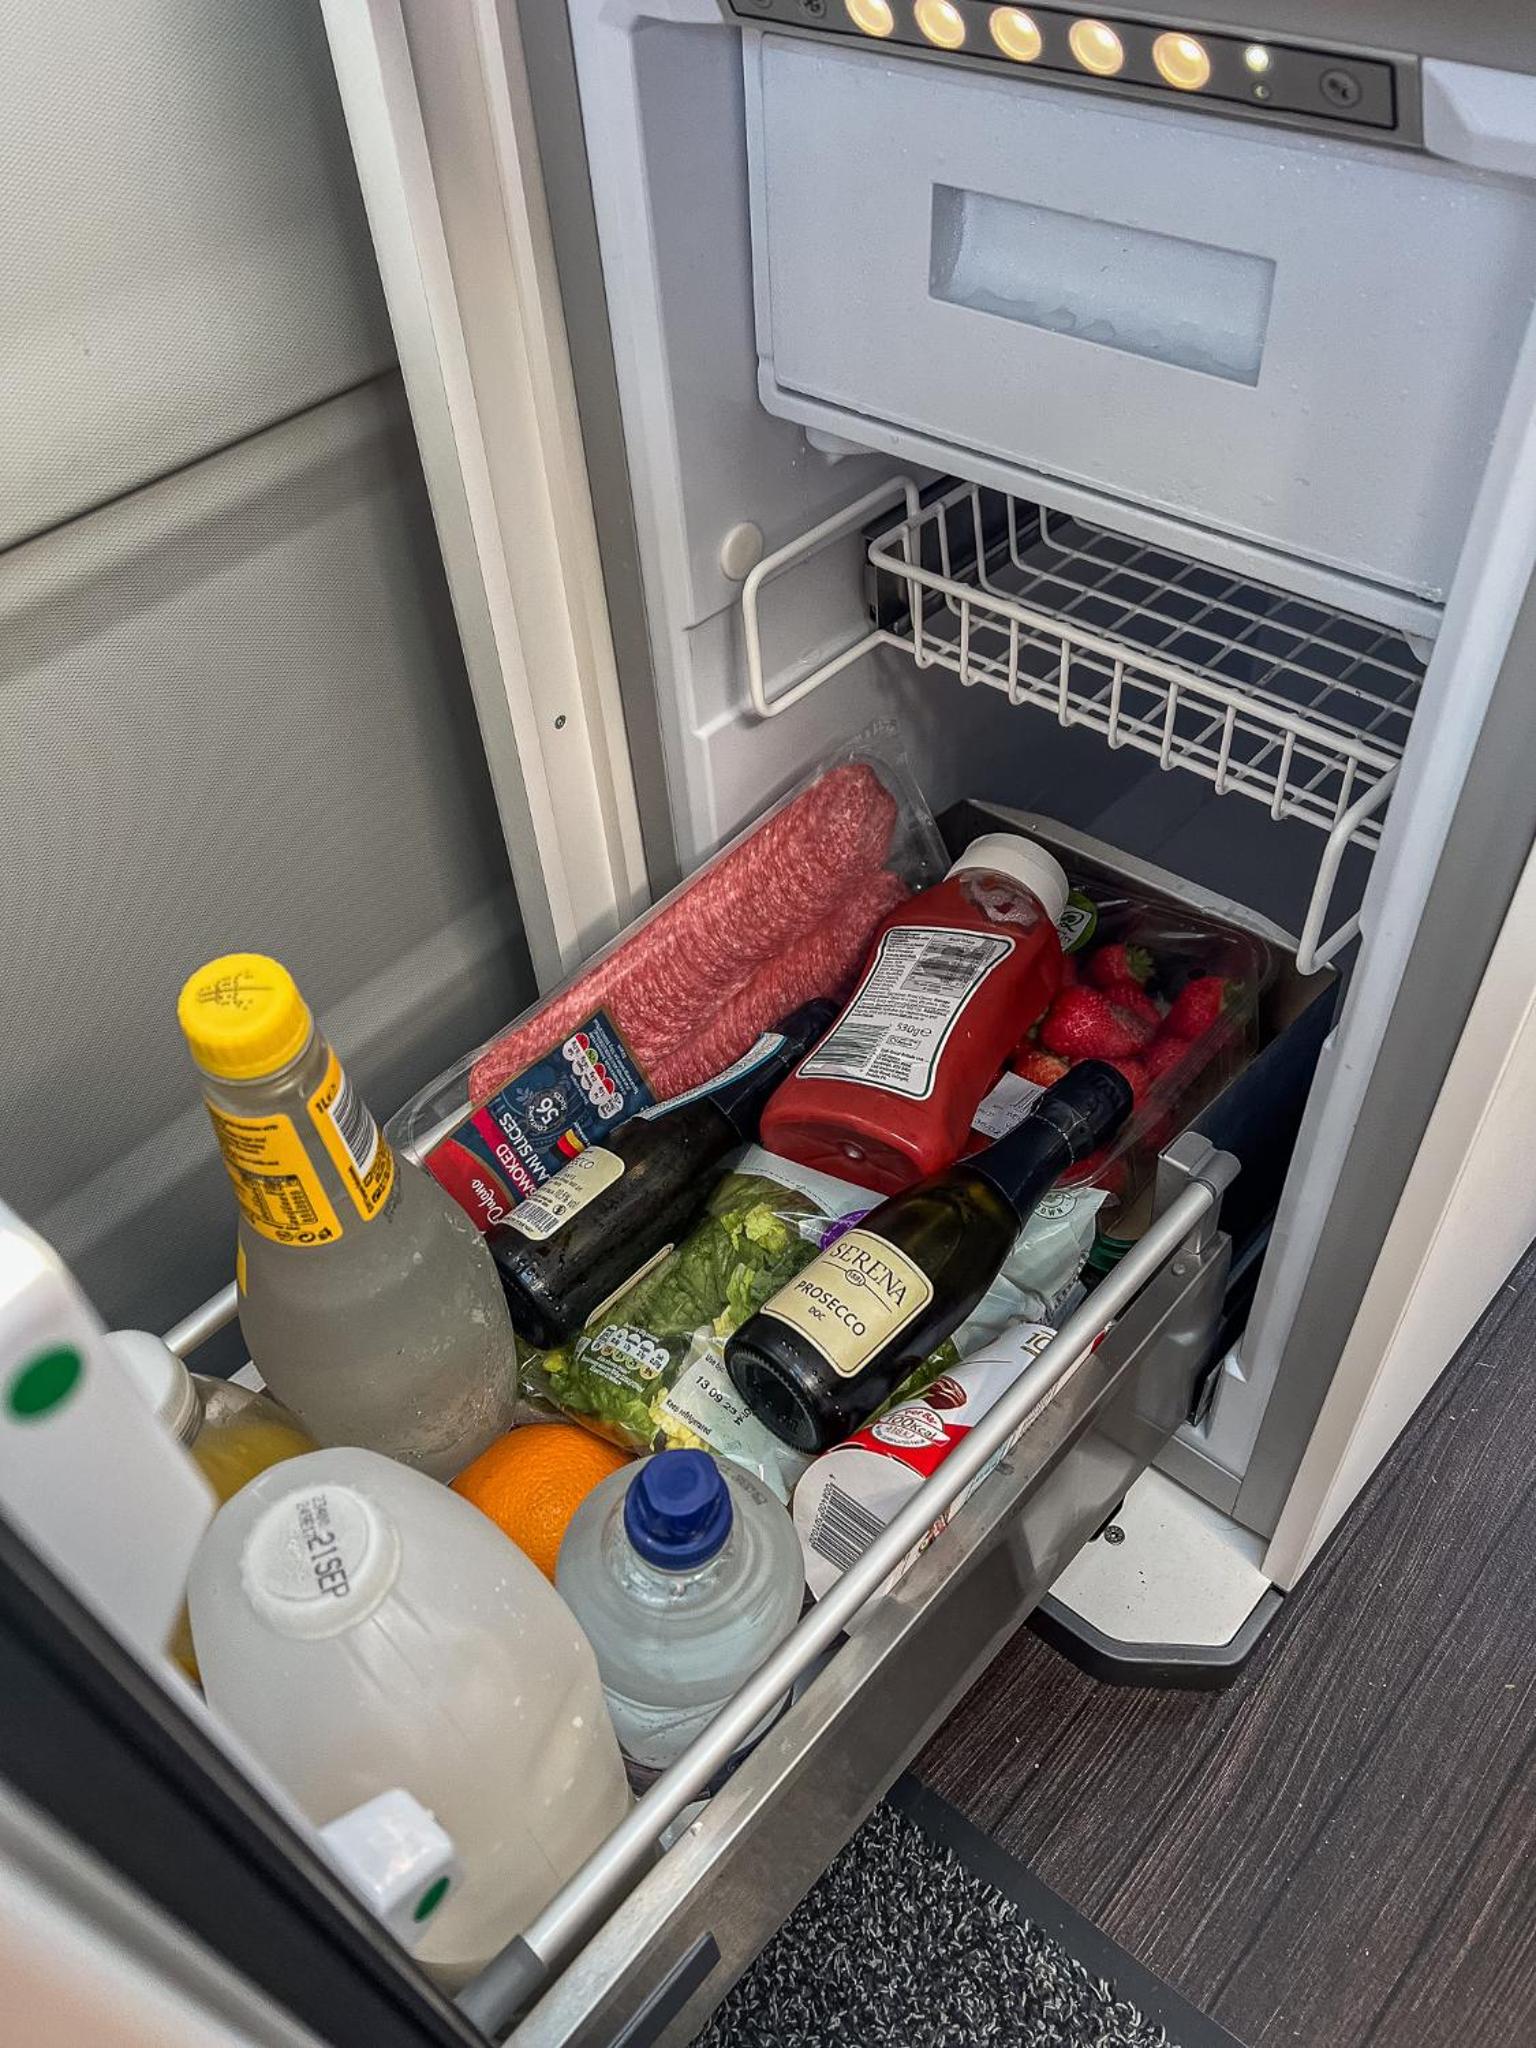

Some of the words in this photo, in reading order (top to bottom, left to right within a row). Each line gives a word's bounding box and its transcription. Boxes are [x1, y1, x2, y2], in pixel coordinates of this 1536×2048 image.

[538, 1097, 560, 1124] 56
[498, 1111, 534, 1157] SLICES
[471, 1178, 504, 1226] Dulano
[829, 1242, 908, 1308] SERENA
[794, 1280, 867, 1337] PROSECCO
[808, 1306, 827, 1322] DOC
[695, 1375, 710, 1391] 13
[708, 1387, 724, 1404] 09
